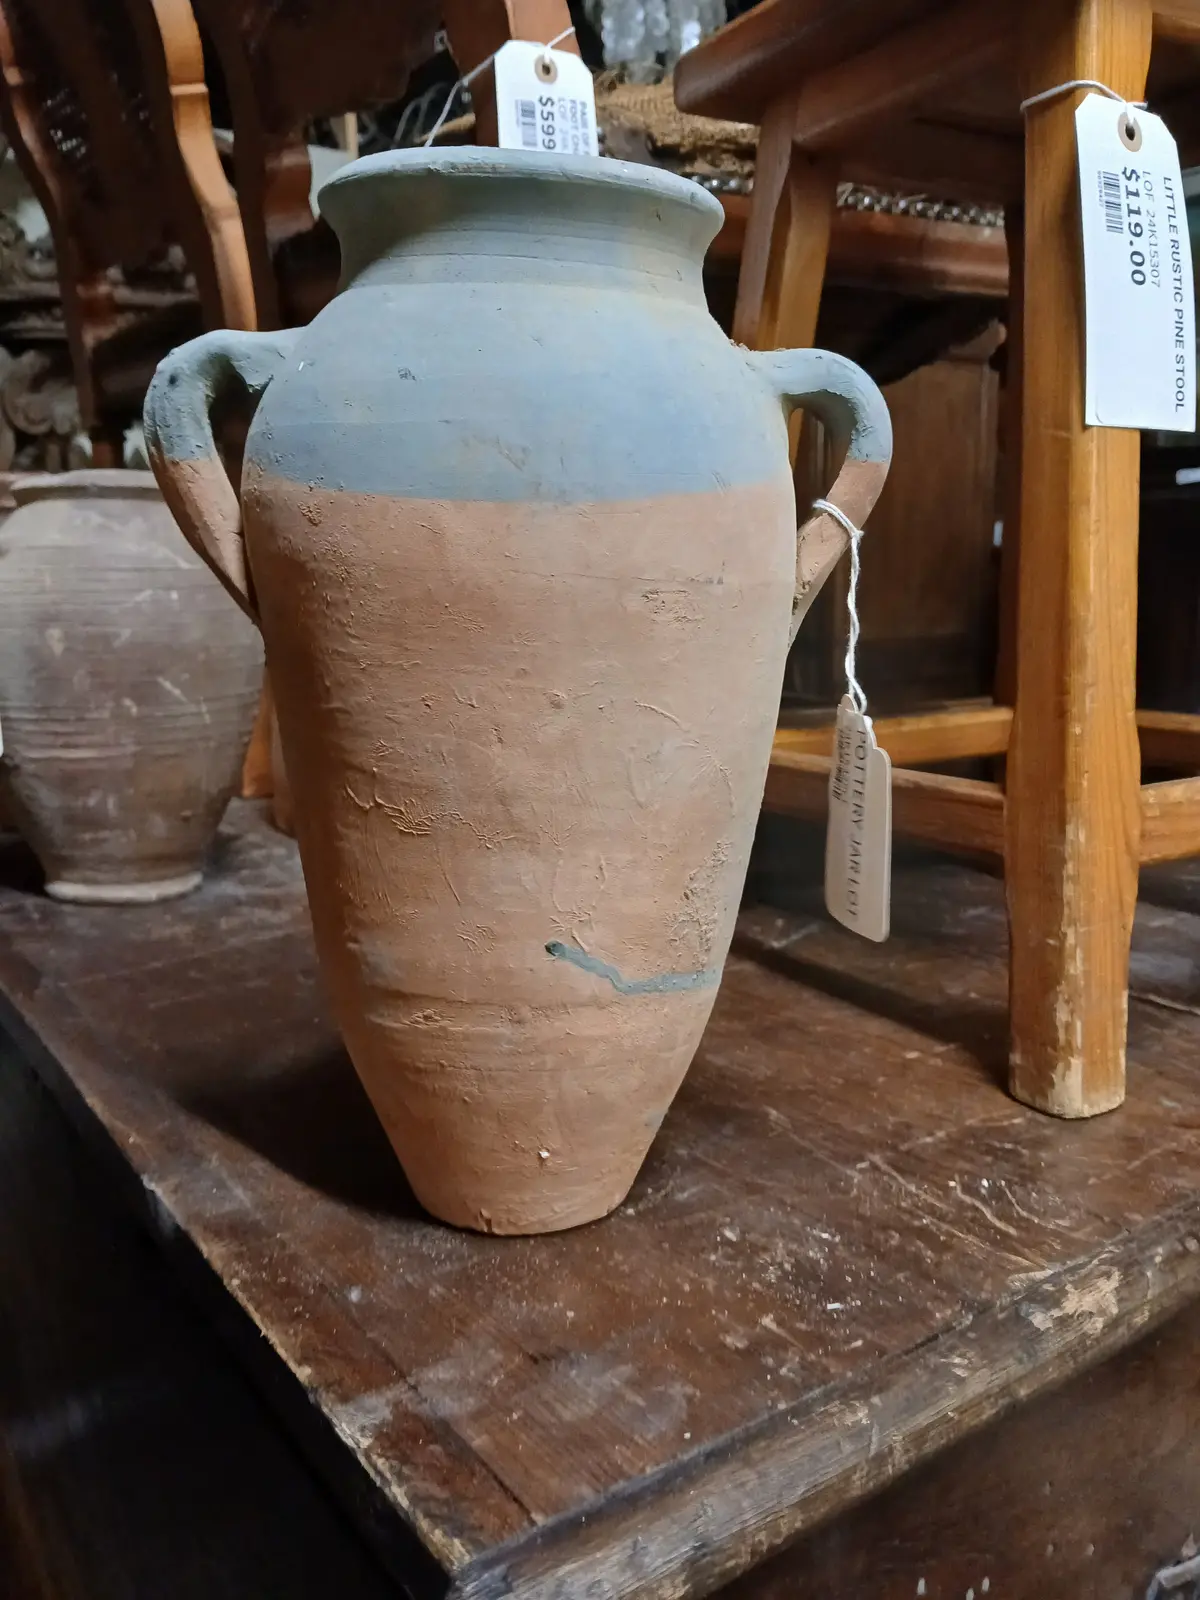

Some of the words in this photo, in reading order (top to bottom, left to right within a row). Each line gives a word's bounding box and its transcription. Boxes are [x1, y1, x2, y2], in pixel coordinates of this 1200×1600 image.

[538, 95, 556, 150] $599
[1142, 171, 1154, 202] LOF
[1163, 176, 1178, 234] LITTLE
[1122, 167, 1146, 286] $119.00
[1146, 209, 1160, 288] 24K15307
[1169, 239, 1184, 303] RUSTIC
[1174, 308, 1185, 349] PINE
[1175, 354, 1186, 412] STOOL
[851, 730, 867, 830] POTTERY
[848, 834, 861, 874] JAR
